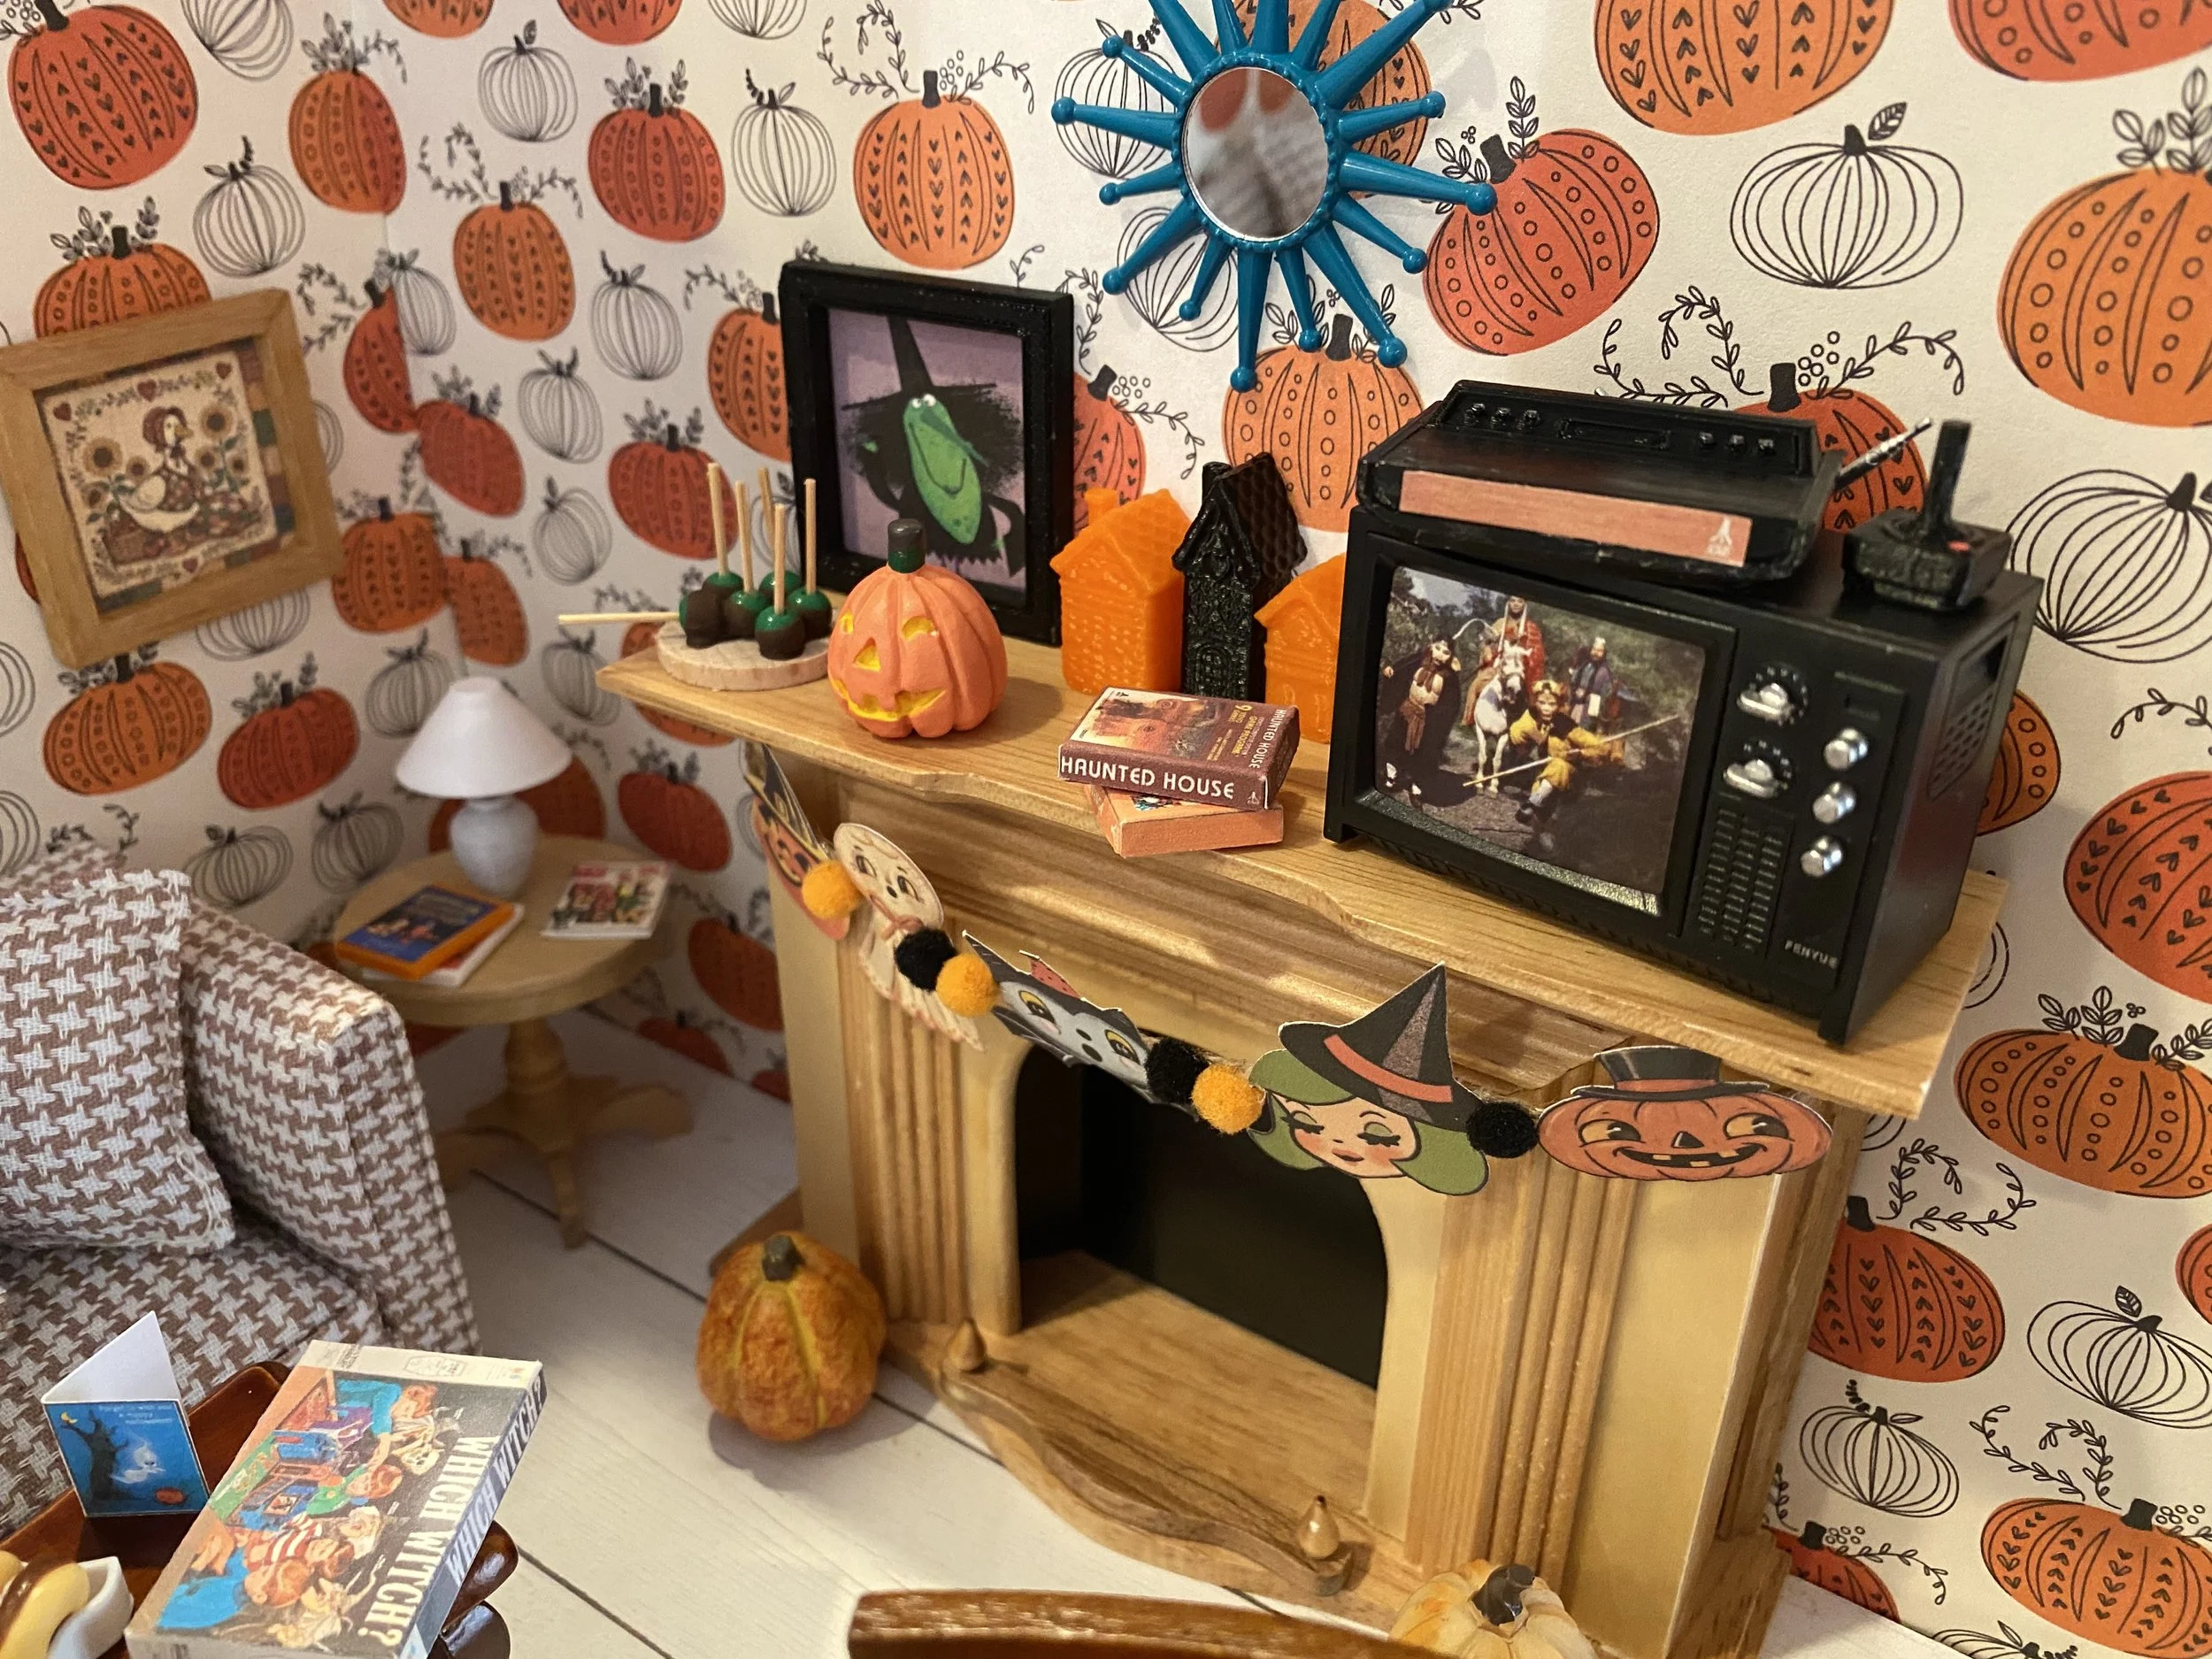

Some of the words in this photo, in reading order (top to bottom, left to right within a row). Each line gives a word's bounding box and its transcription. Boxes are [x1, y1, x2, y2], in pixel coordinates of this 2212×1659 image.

[1248, 742, 1271, 769] HOUSE
[1263, 709, 1286, 741] HAUNTED
[1061, 756, 1156, 787] HAUNTED
[1164, 772, 1235, 800] HOUSE
[419, 1435, 501, 1523] WHICH
[447, 1475, 499, 1587] WHICH
[495, 1379, 543, 1488] WITCH?
[357, 1528, 456, 1646] WITCH?
